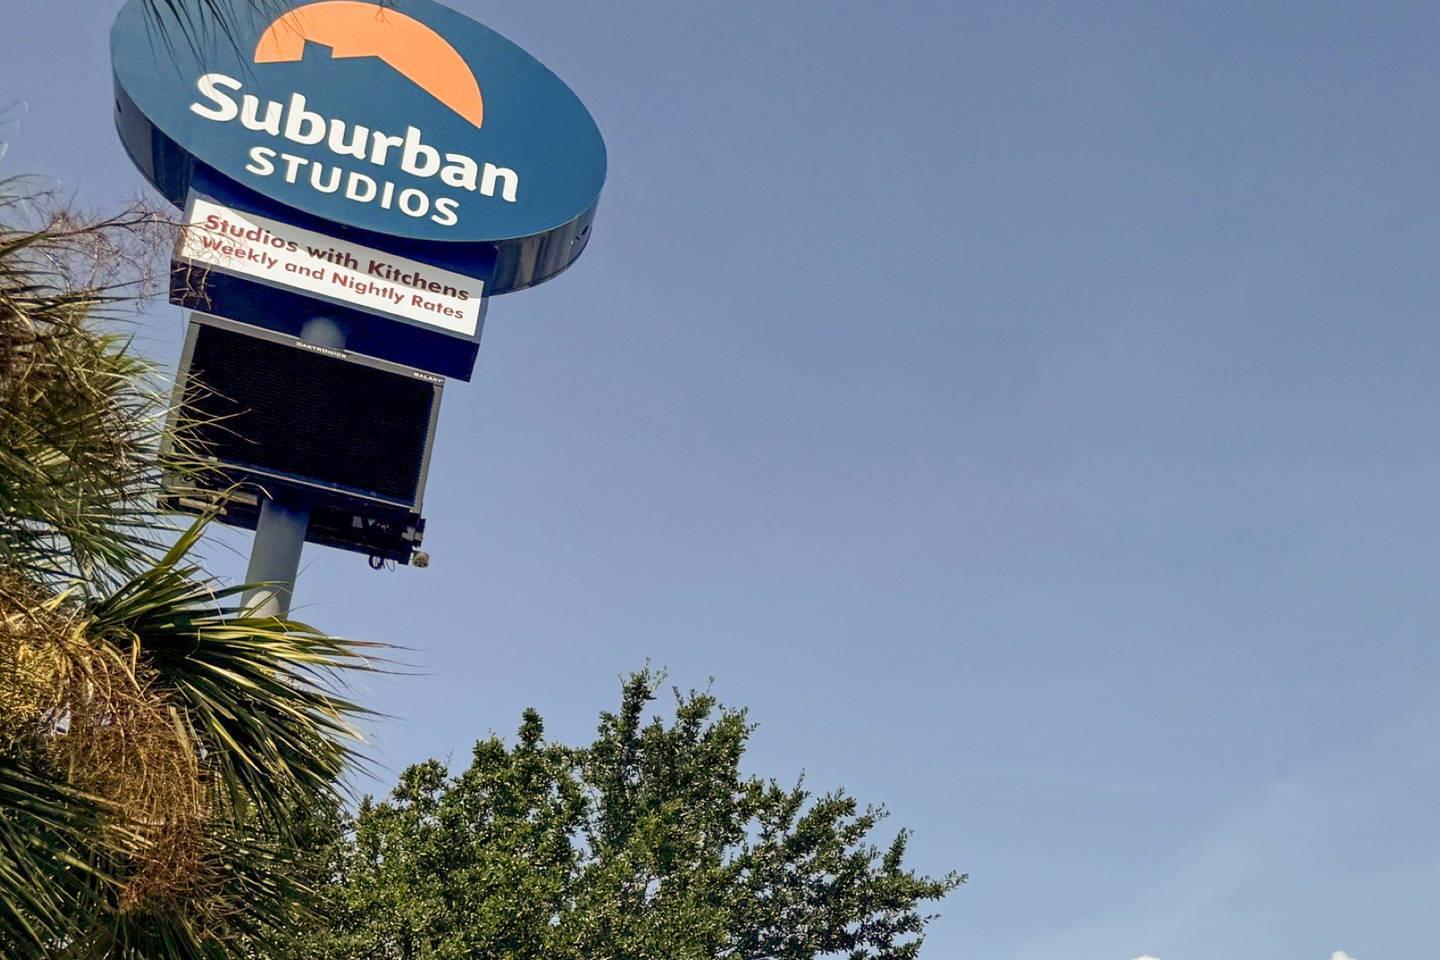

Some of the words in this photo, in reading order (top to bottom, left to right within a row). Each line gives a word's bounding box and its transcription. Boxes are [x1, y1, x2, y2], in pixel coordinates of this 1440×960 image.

[189, 73, 519, 202] Suburban
[245, 146, 460, 227] STUDIOS
[202, 236, 278, 269] Weekly
[284, 261, 326, 280] and
[331, 272, 405, 305] Nightly
[411, 294, 464, 319] Rates
[204, 214, 299, 253] Studios
[306, 246, 359, 271] with
[367, 259, 470, 301] Kitchens
